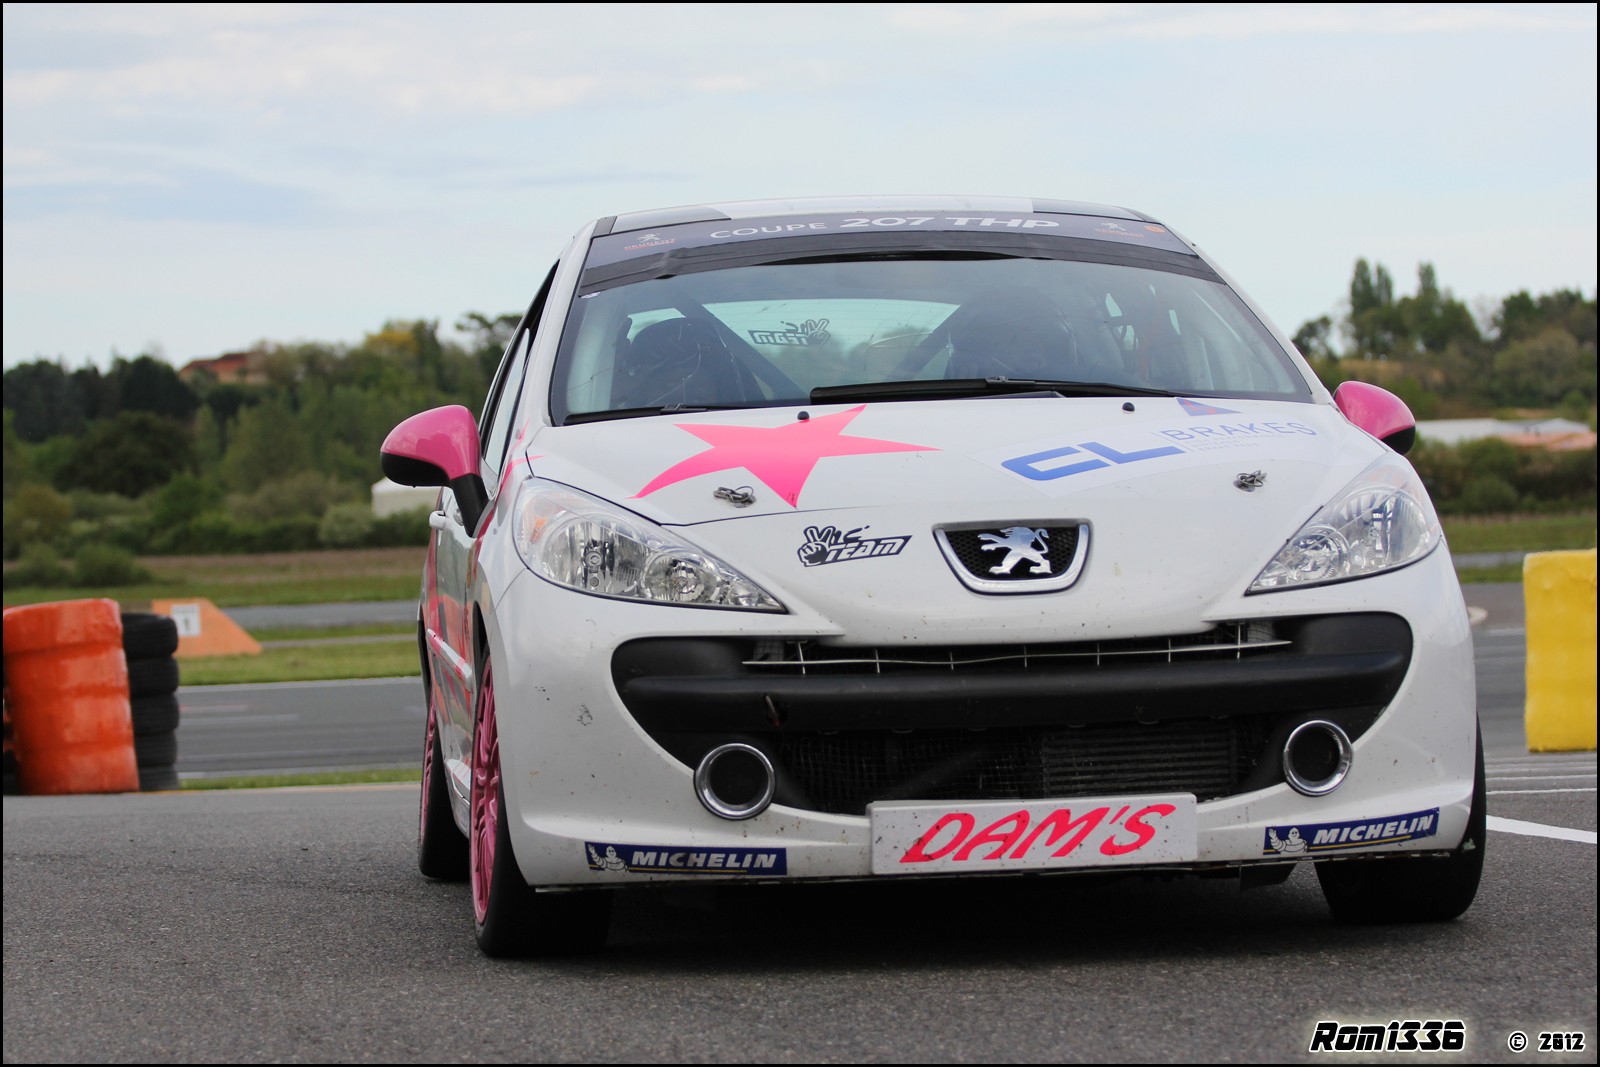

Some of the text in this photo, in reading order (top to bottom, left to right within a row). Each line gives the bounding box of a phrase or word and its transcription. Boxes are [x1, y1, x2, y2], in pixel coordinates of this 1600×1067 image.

[710, 216, 1061, 239] COUPE 207 THP
[1001, 441, 1187, 481] CL
[1160, 422, 1318, 441] BRAKES
[900, 803, 1177, 863] DAM'S
[1312, 814, 1434, 845] MICHELIN
[631, 850, 777, 868] MICHELIN
